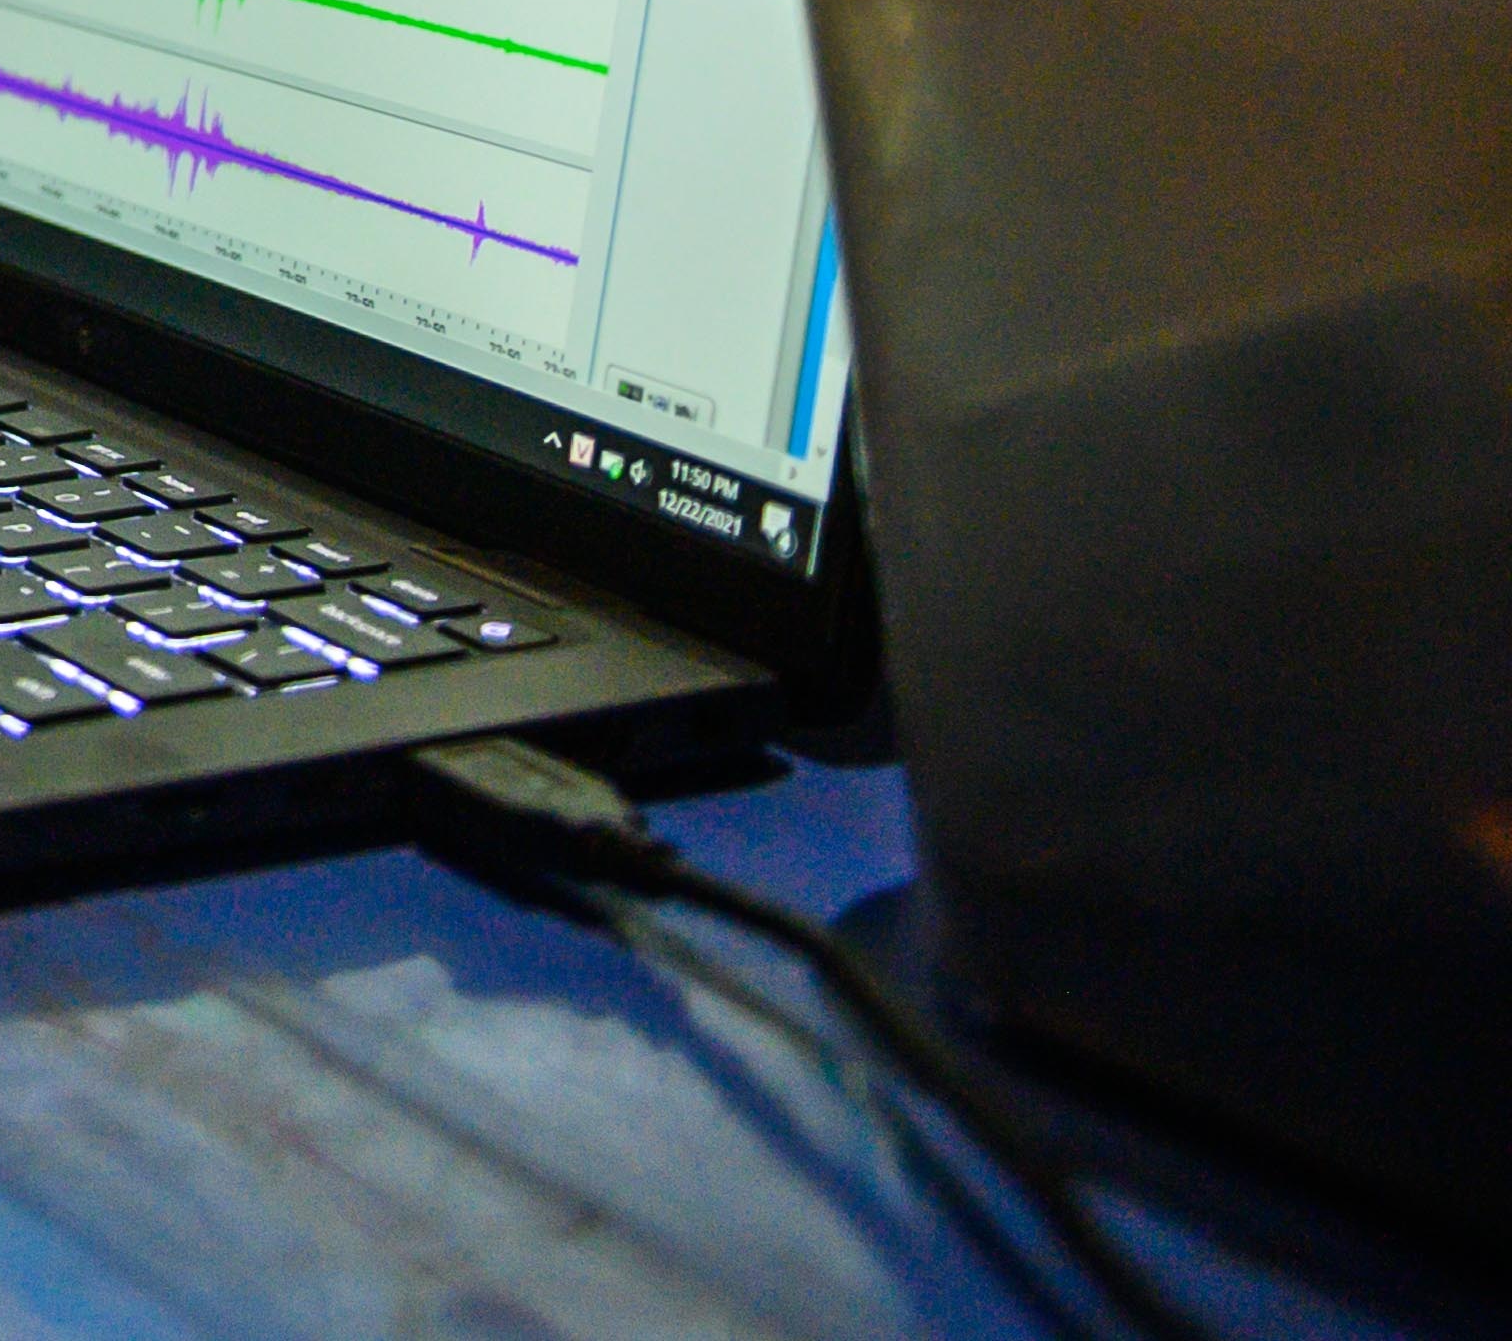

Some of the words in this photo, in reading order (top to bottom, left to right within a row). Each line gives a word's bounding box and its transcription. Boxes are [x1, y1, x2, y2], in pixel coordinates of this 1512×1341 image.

[671, 459, 712, 489] 11:50
[713, 473, 740, 501] PM
[658, 488, 743, 537] 12/22/2021
